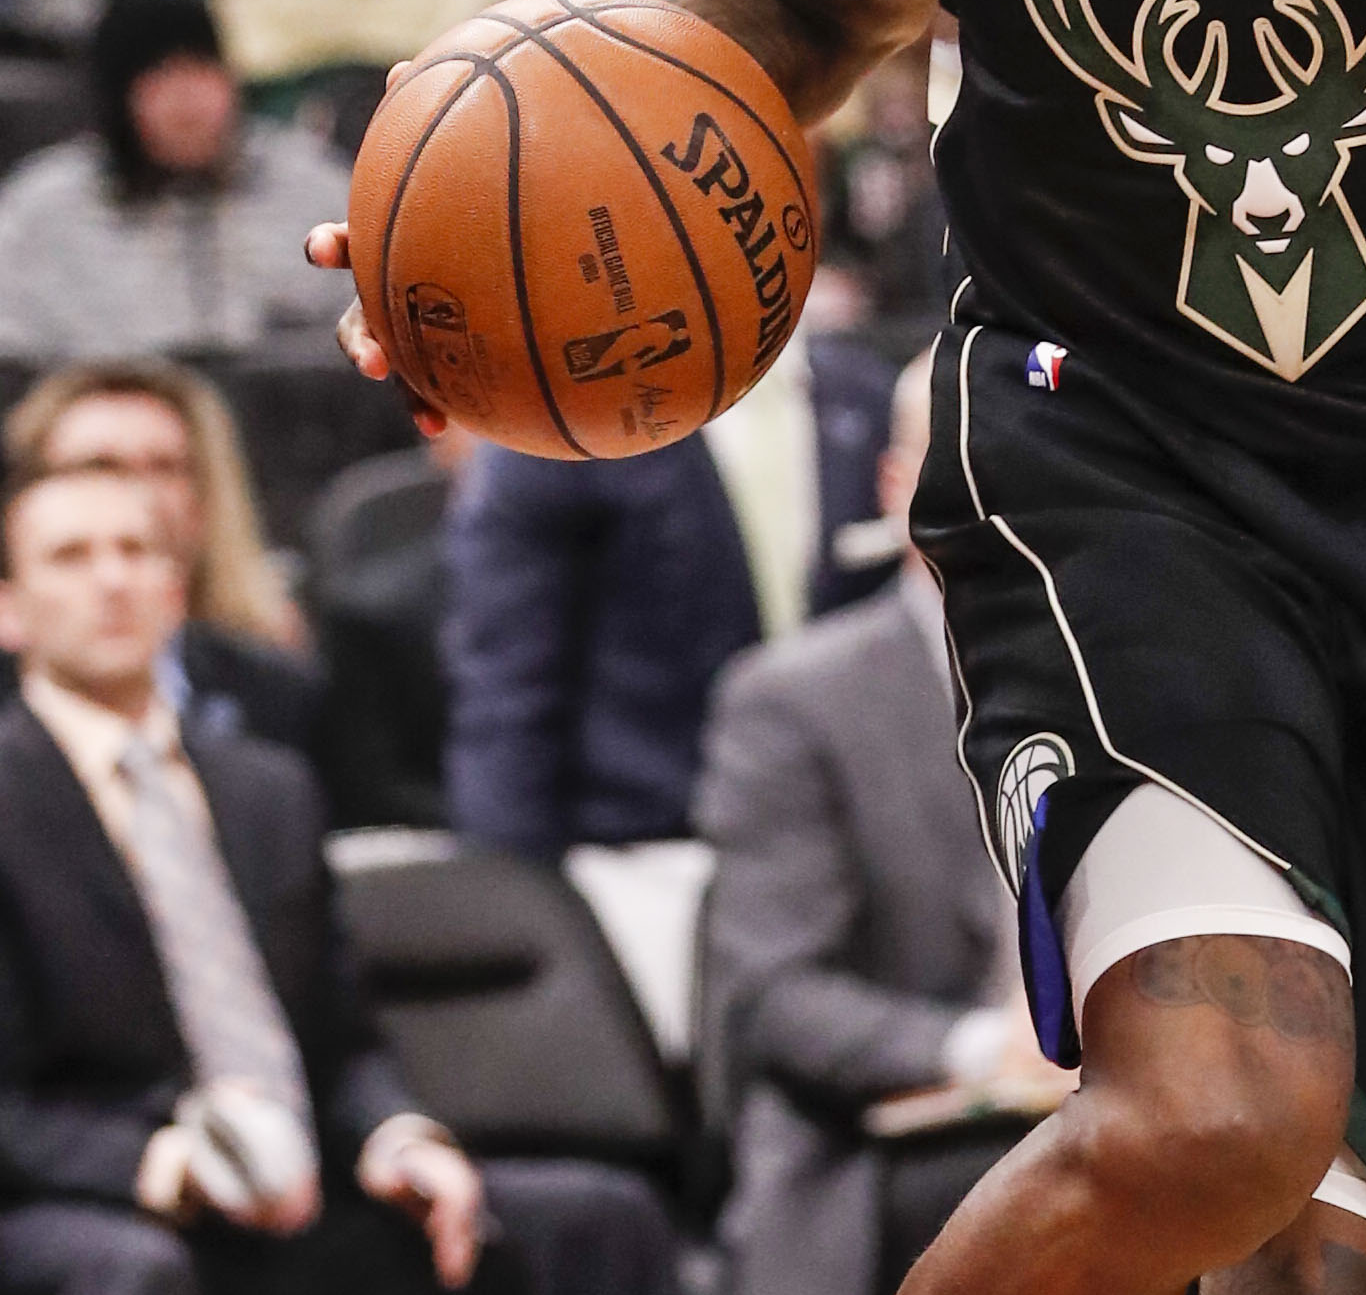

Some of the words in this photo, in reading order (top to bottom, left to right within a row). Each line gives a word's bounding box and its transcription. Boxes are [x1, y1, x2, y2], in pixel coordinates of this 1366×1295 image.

[588, 205, 620, 256] OFFICIAL
[602, 254, 629, 288] GAME
[611, 285, 636, 315] BALL
